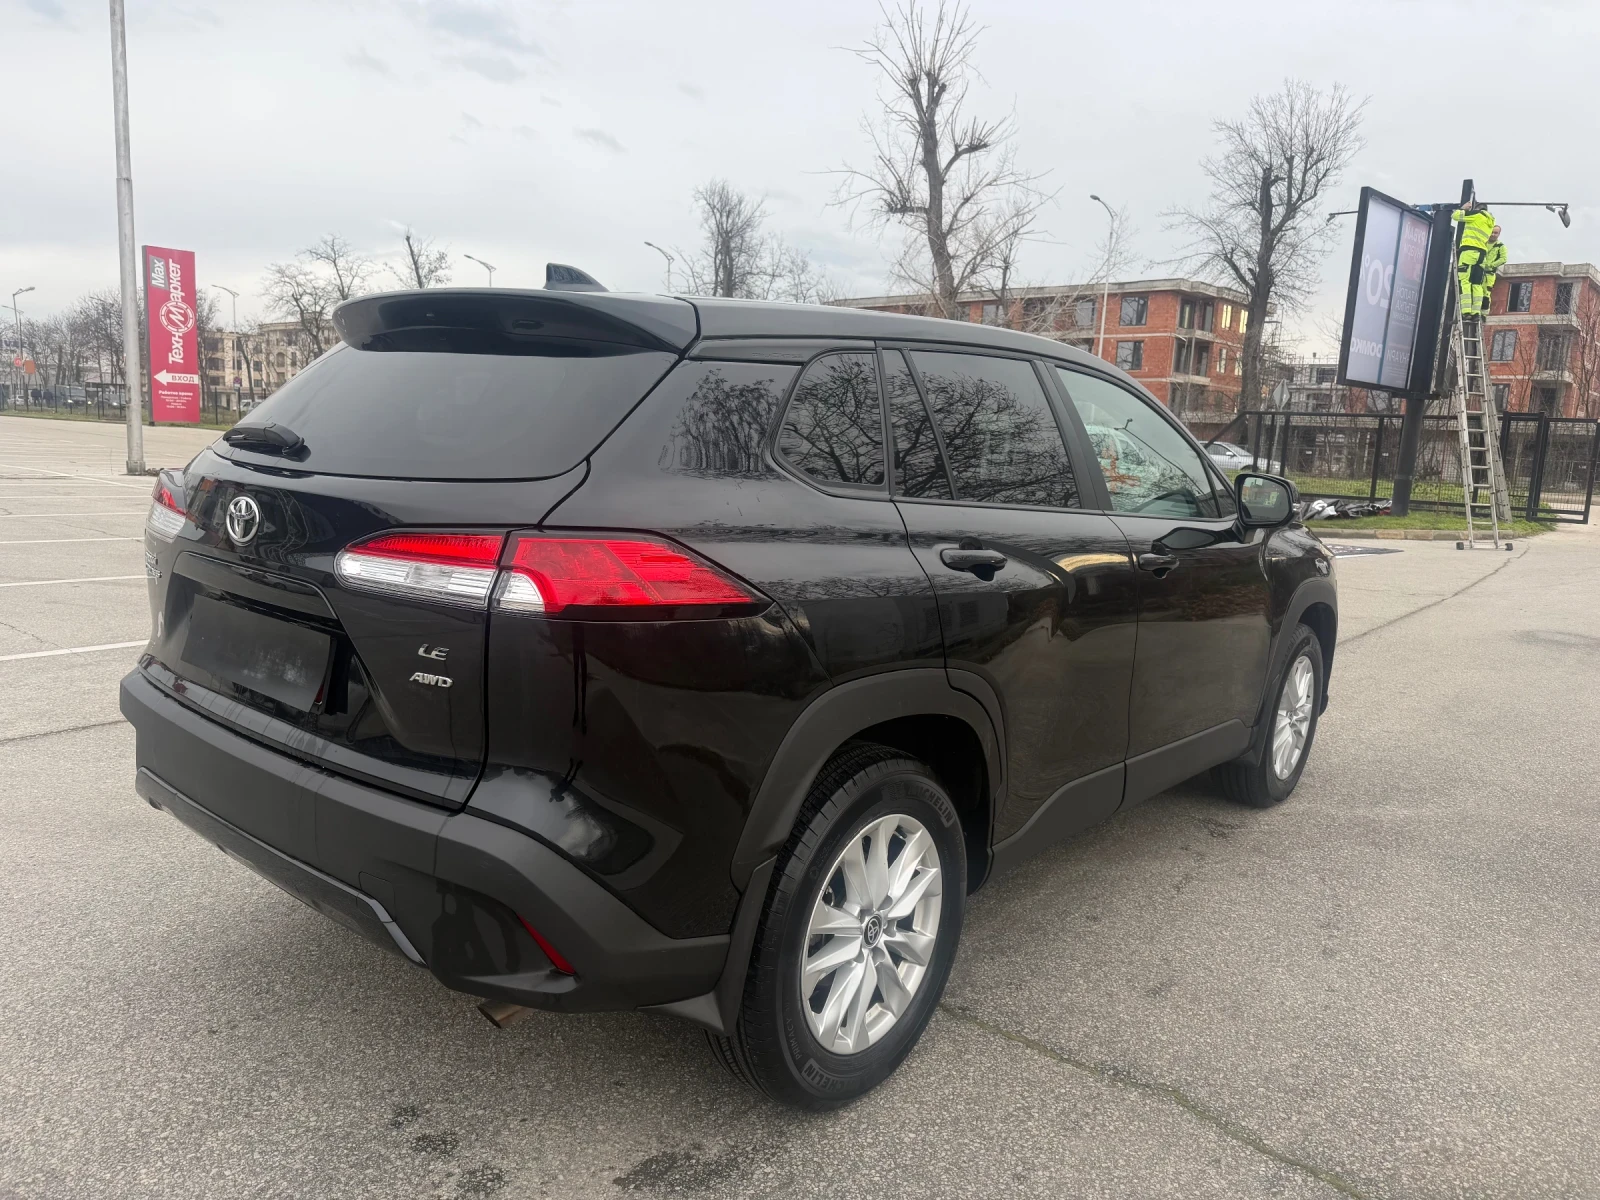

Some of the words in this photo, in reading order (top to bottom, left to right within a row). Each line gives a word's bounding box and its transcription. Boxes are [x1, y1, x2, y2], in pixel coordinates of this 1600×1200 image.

[152, 259, 165, 288] Max
[171, 375, 195, 383] ВХОД
[418, 643, 449, 660] LE
[409, 672, 453, 688] AWD
